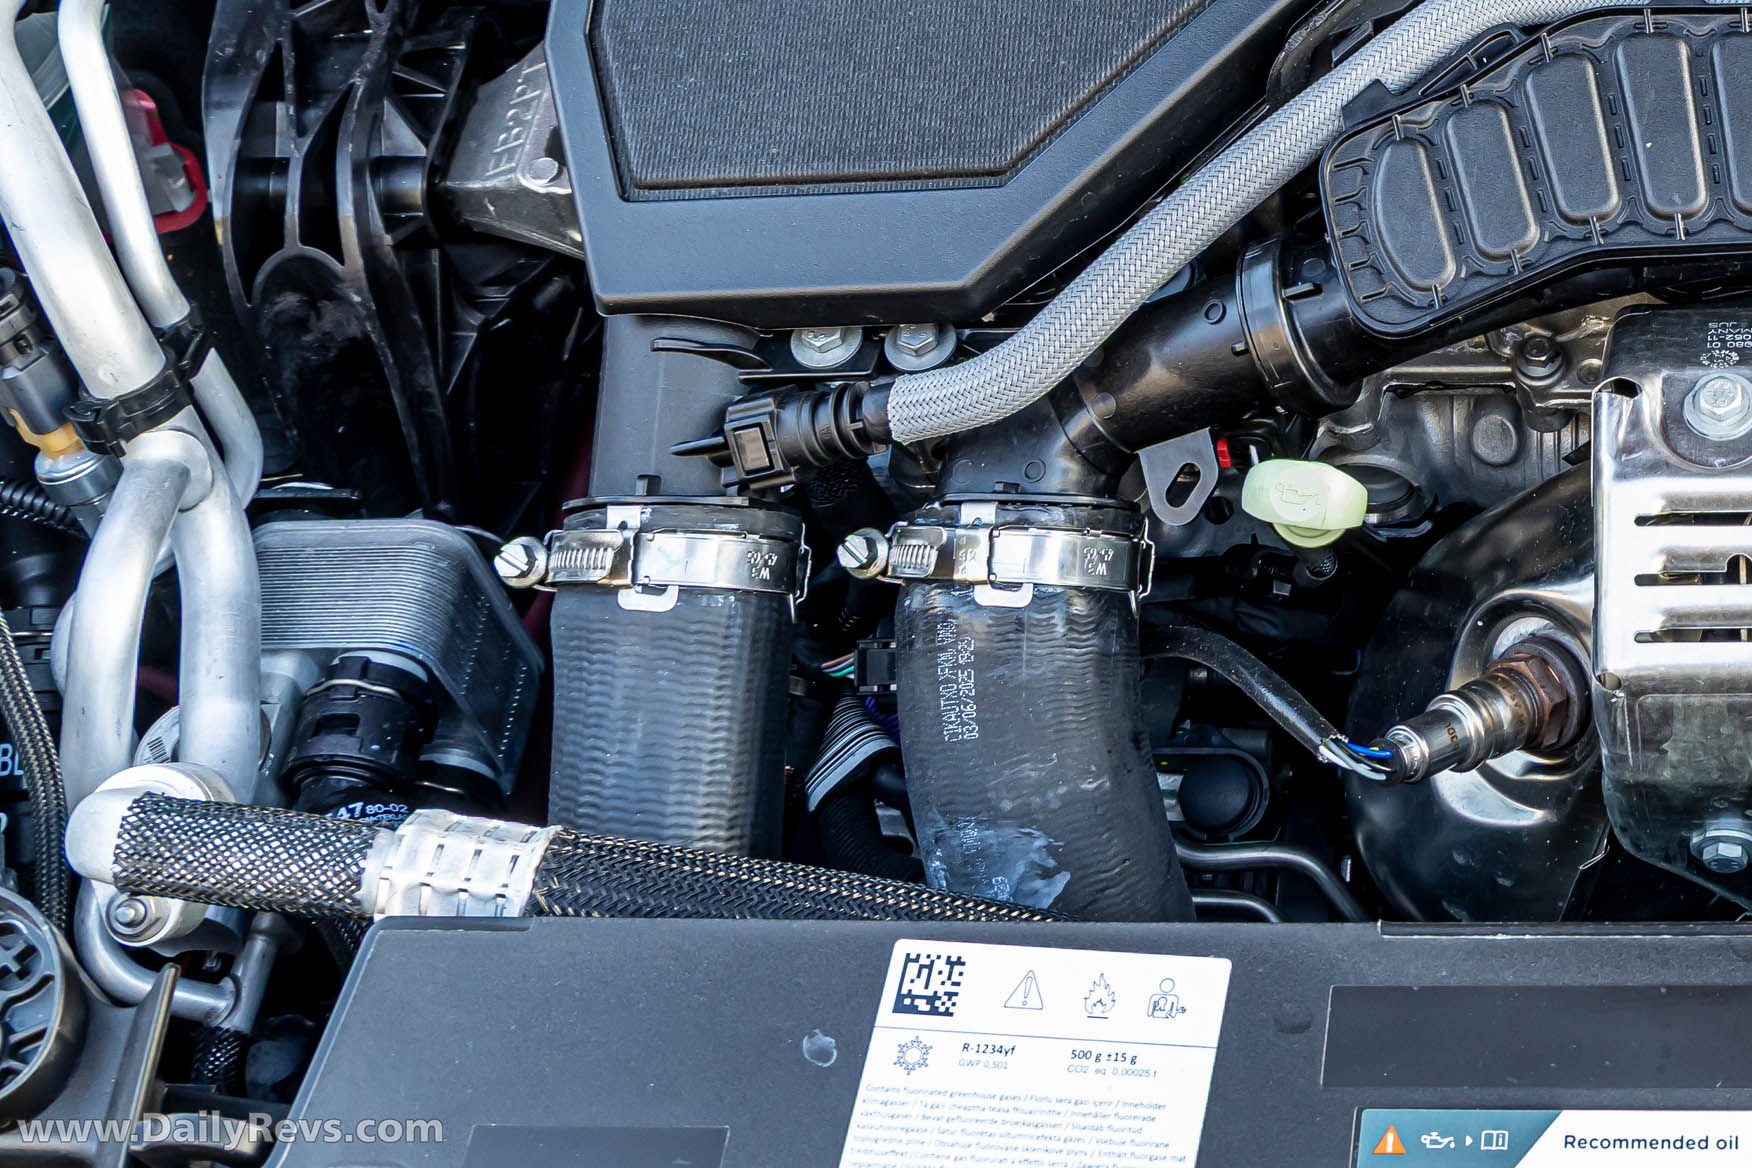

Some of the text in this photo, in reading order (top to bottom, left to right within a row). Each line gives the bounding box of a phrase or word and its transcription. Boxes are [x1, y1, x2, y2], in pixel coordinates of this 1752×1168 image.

[962, 1042, 1016, 1057] R-1234yf
[1070, 1049, 1093, 1061] 500
[1094, 1052, 1102, 1063] g
[1130, 1054, 1138, 1065] g
[1564, 1134, 1740, 1150] Recommended oil
